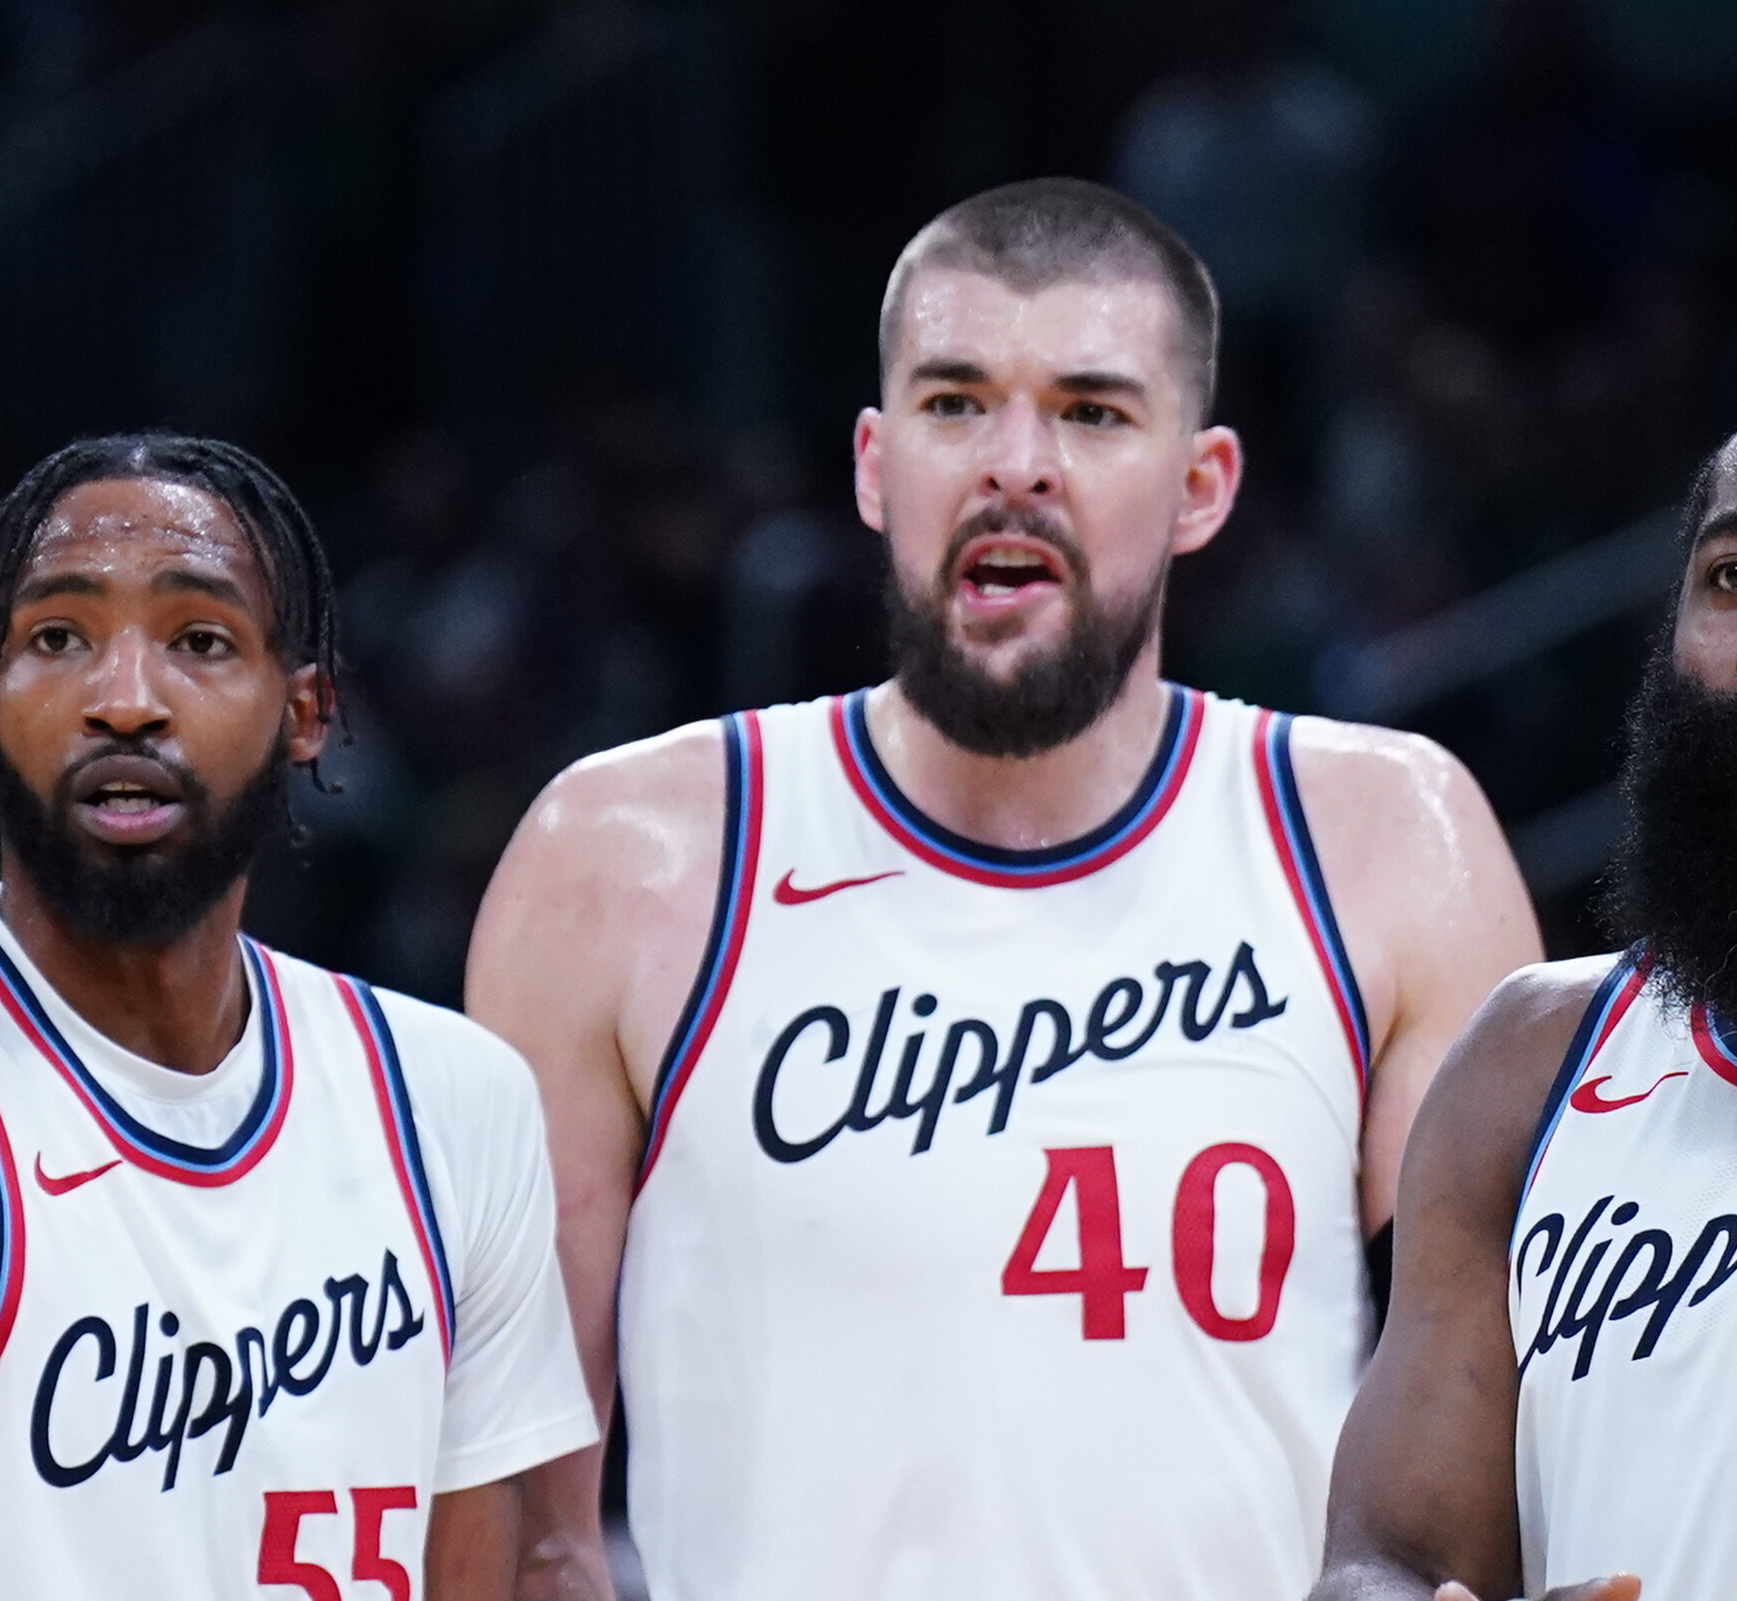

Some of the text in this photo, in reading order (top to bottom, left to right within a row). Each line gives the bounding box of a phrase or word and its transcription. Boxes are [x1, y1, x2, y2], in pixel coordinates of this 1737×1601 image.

[752, 940, 1288, 1164] Clippers
[1001, 1142, 1295, 1342] 40
[30, 1247, 424, 1493] Clippers
